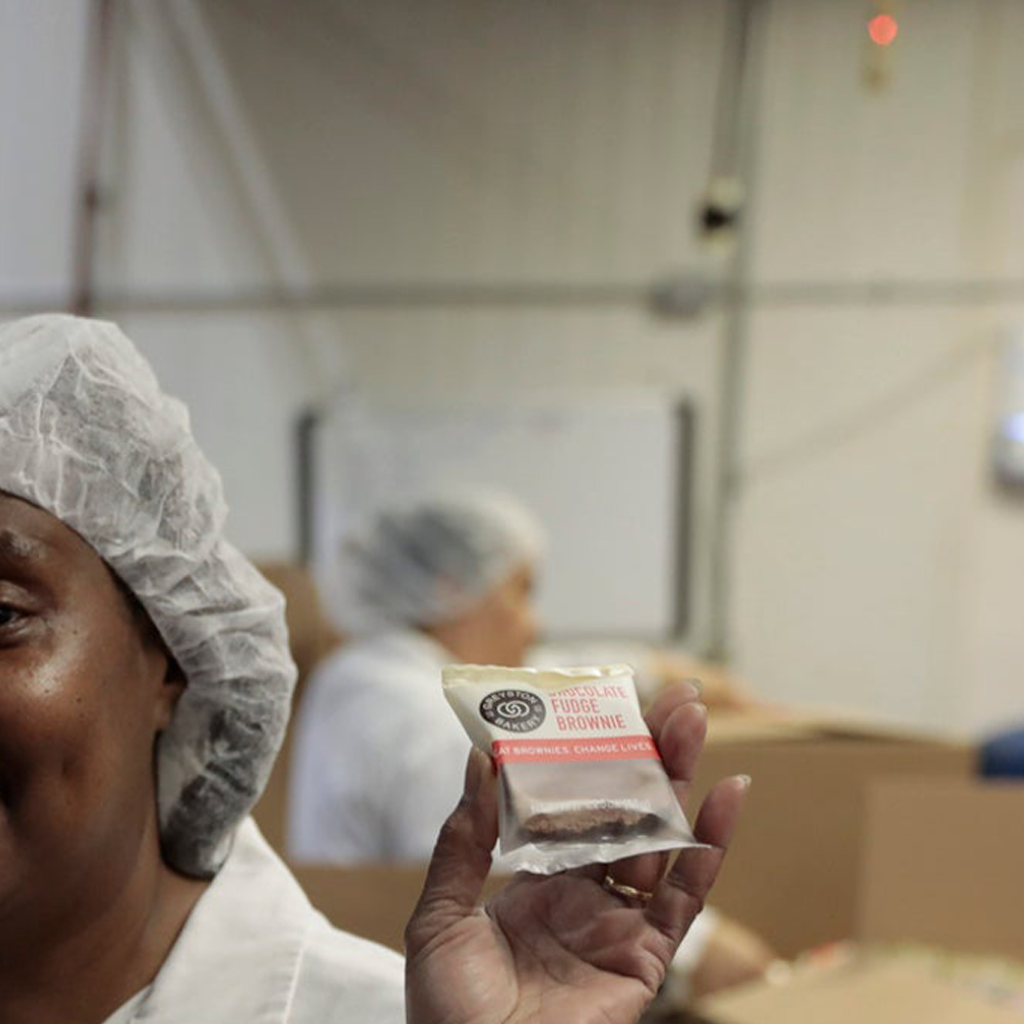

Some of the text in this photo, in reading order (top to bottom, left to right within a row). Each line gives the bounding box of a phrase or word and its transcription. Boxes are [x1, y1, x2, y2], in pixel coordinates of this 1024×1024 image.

[551, 699, 601, 713] FUDGE
[495, 715, 541, 730] BAKERY
[556, 714, 627, 731] BROWNIE
[573, 744, 618, 754] CHANGE
